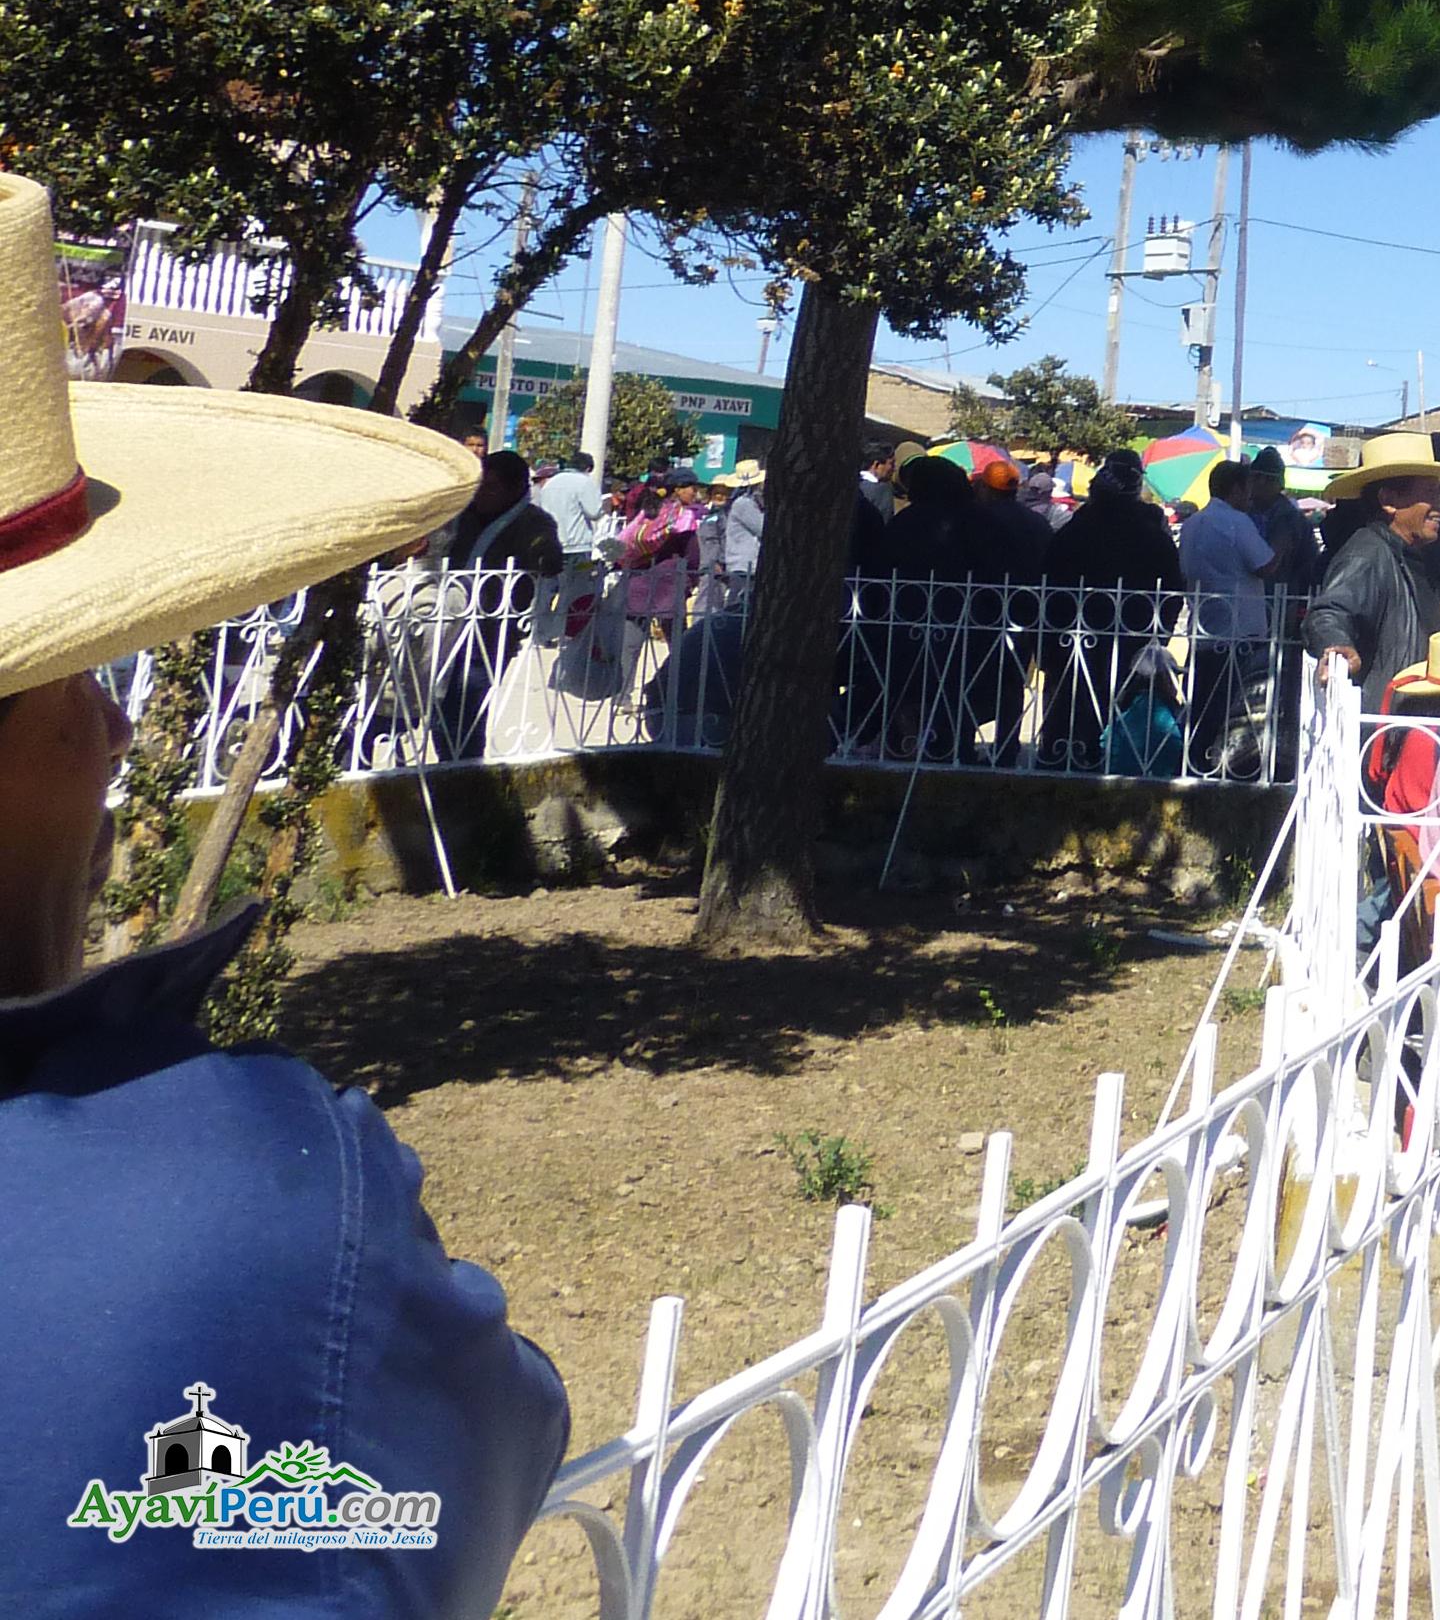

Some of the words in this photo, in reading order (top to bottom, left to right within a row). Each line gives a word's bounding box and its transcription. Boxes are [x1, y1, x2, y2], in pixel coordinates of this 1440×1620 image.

[148, 327, 195, 345] AYAVI
[478, 373, 535, 392] PUSTO
[680, 395, 706, 409] PNP
[713, 398, 750, 413] AYAVI
